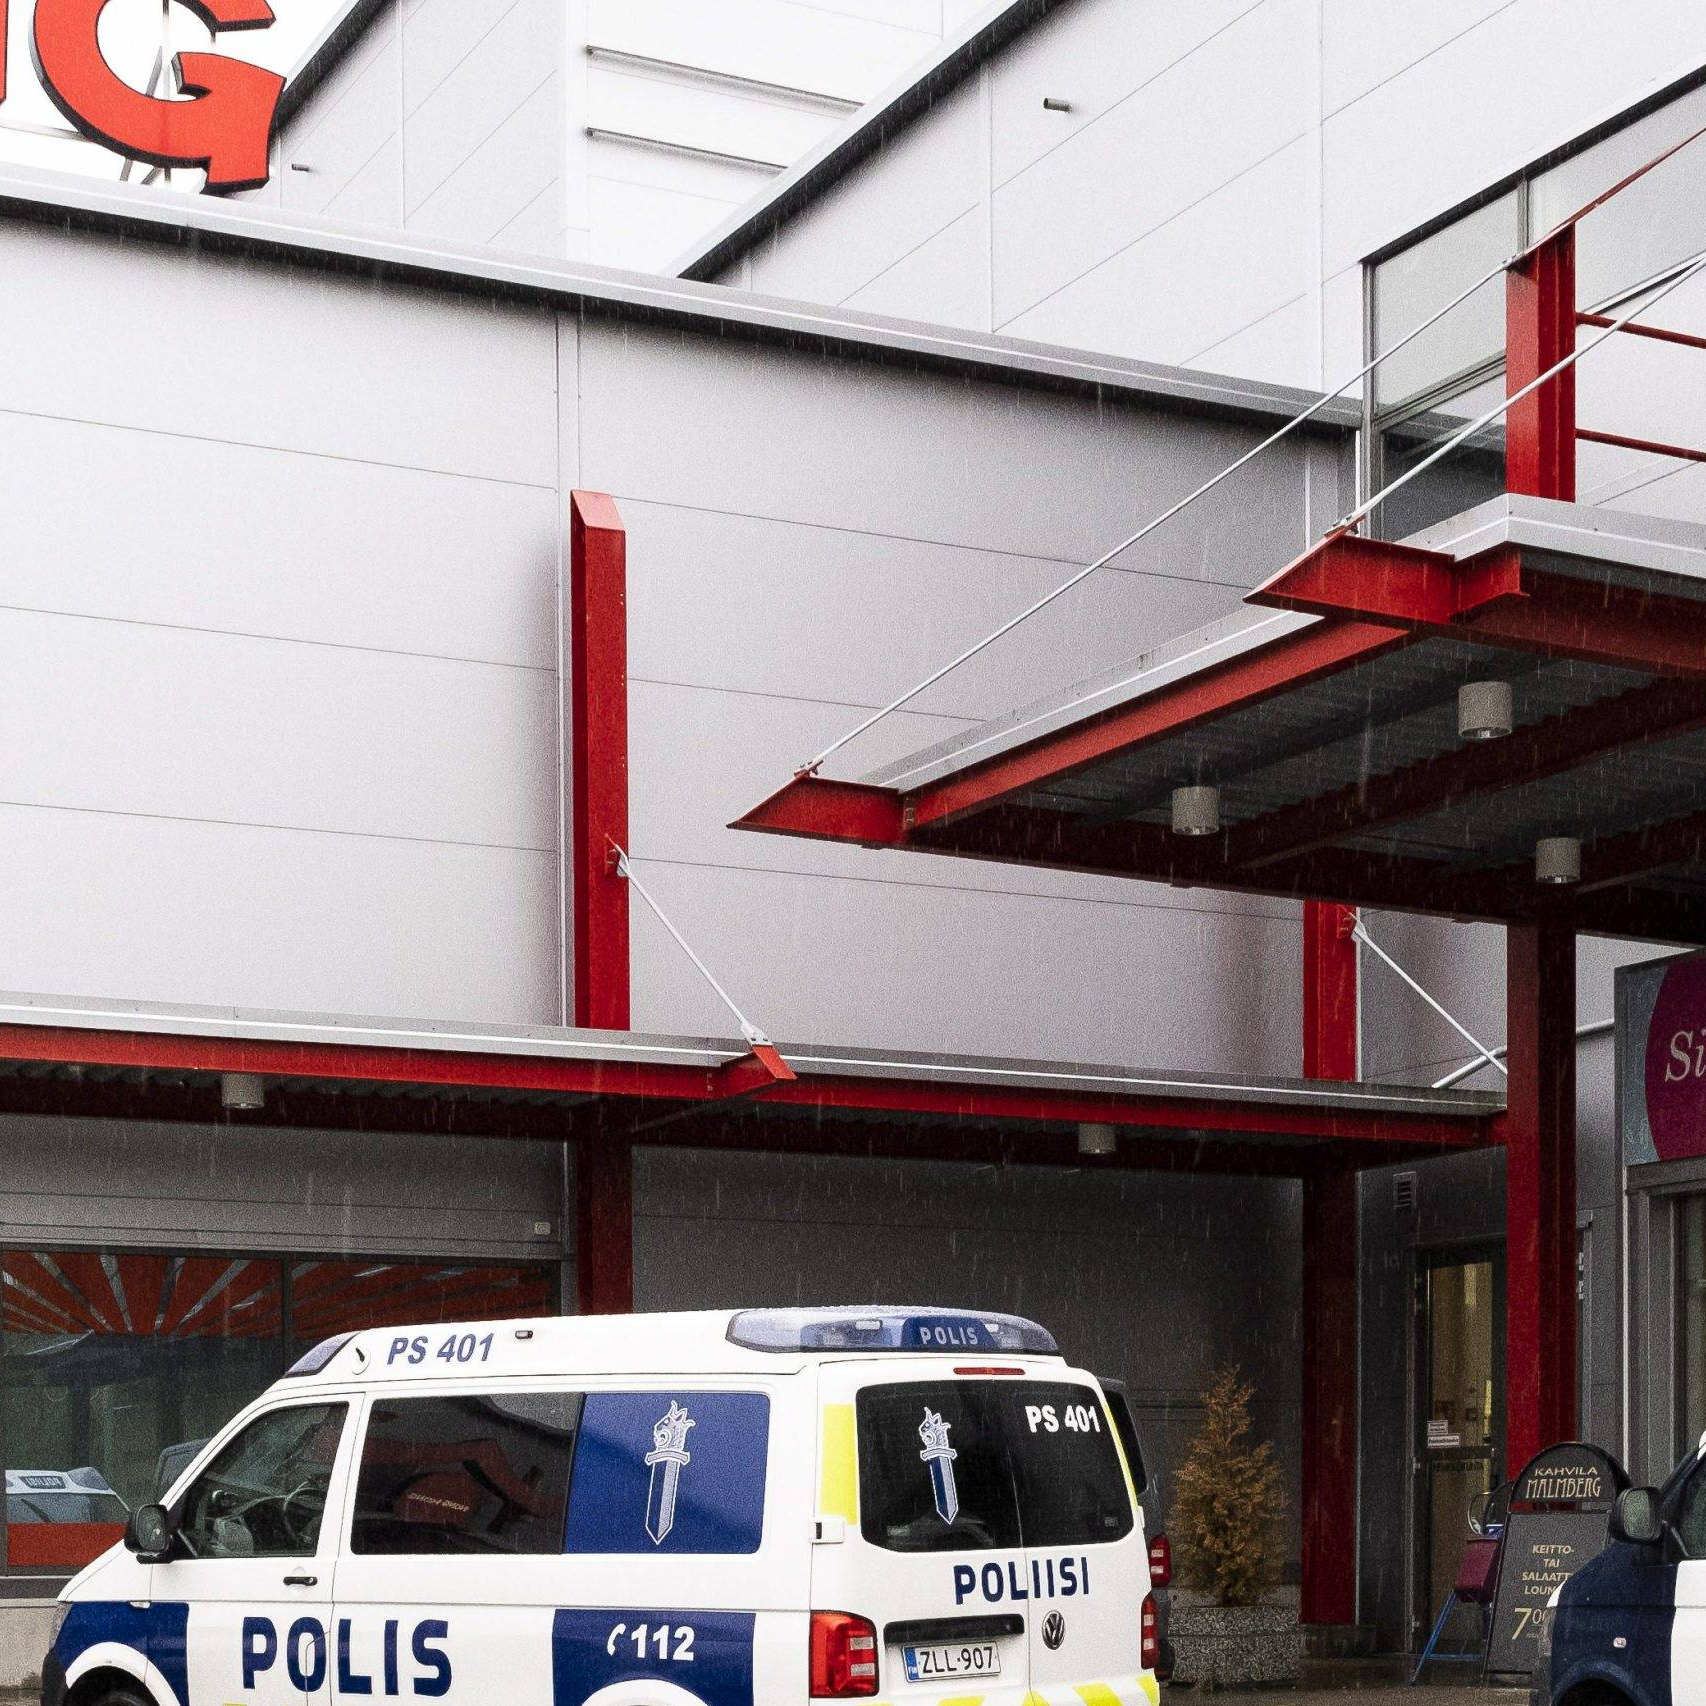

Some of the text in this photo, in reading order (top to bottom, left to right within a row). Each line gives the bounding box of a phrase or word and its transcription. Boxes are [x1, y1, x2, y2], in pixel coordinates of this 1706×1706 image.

[920, 1326, 978, 1346] POLIS
[387, 1333, 494, 1365] PS 401
[1025, 1405, 1101, 1433] PS 401
[1535, 1466, 1598, 1477] KAHVILA
[1525, 1477, 1601, 1499] MALMBERG
[1544, 1558, 1560, 1568] TAI
[953, 1557, 1089, 1605] POLIISI
[1522, 1571, 1574, 1582] SALAATT
[631, 1624, 695, 1661] 112
[242, 1616, 452, 1697] POLIS
